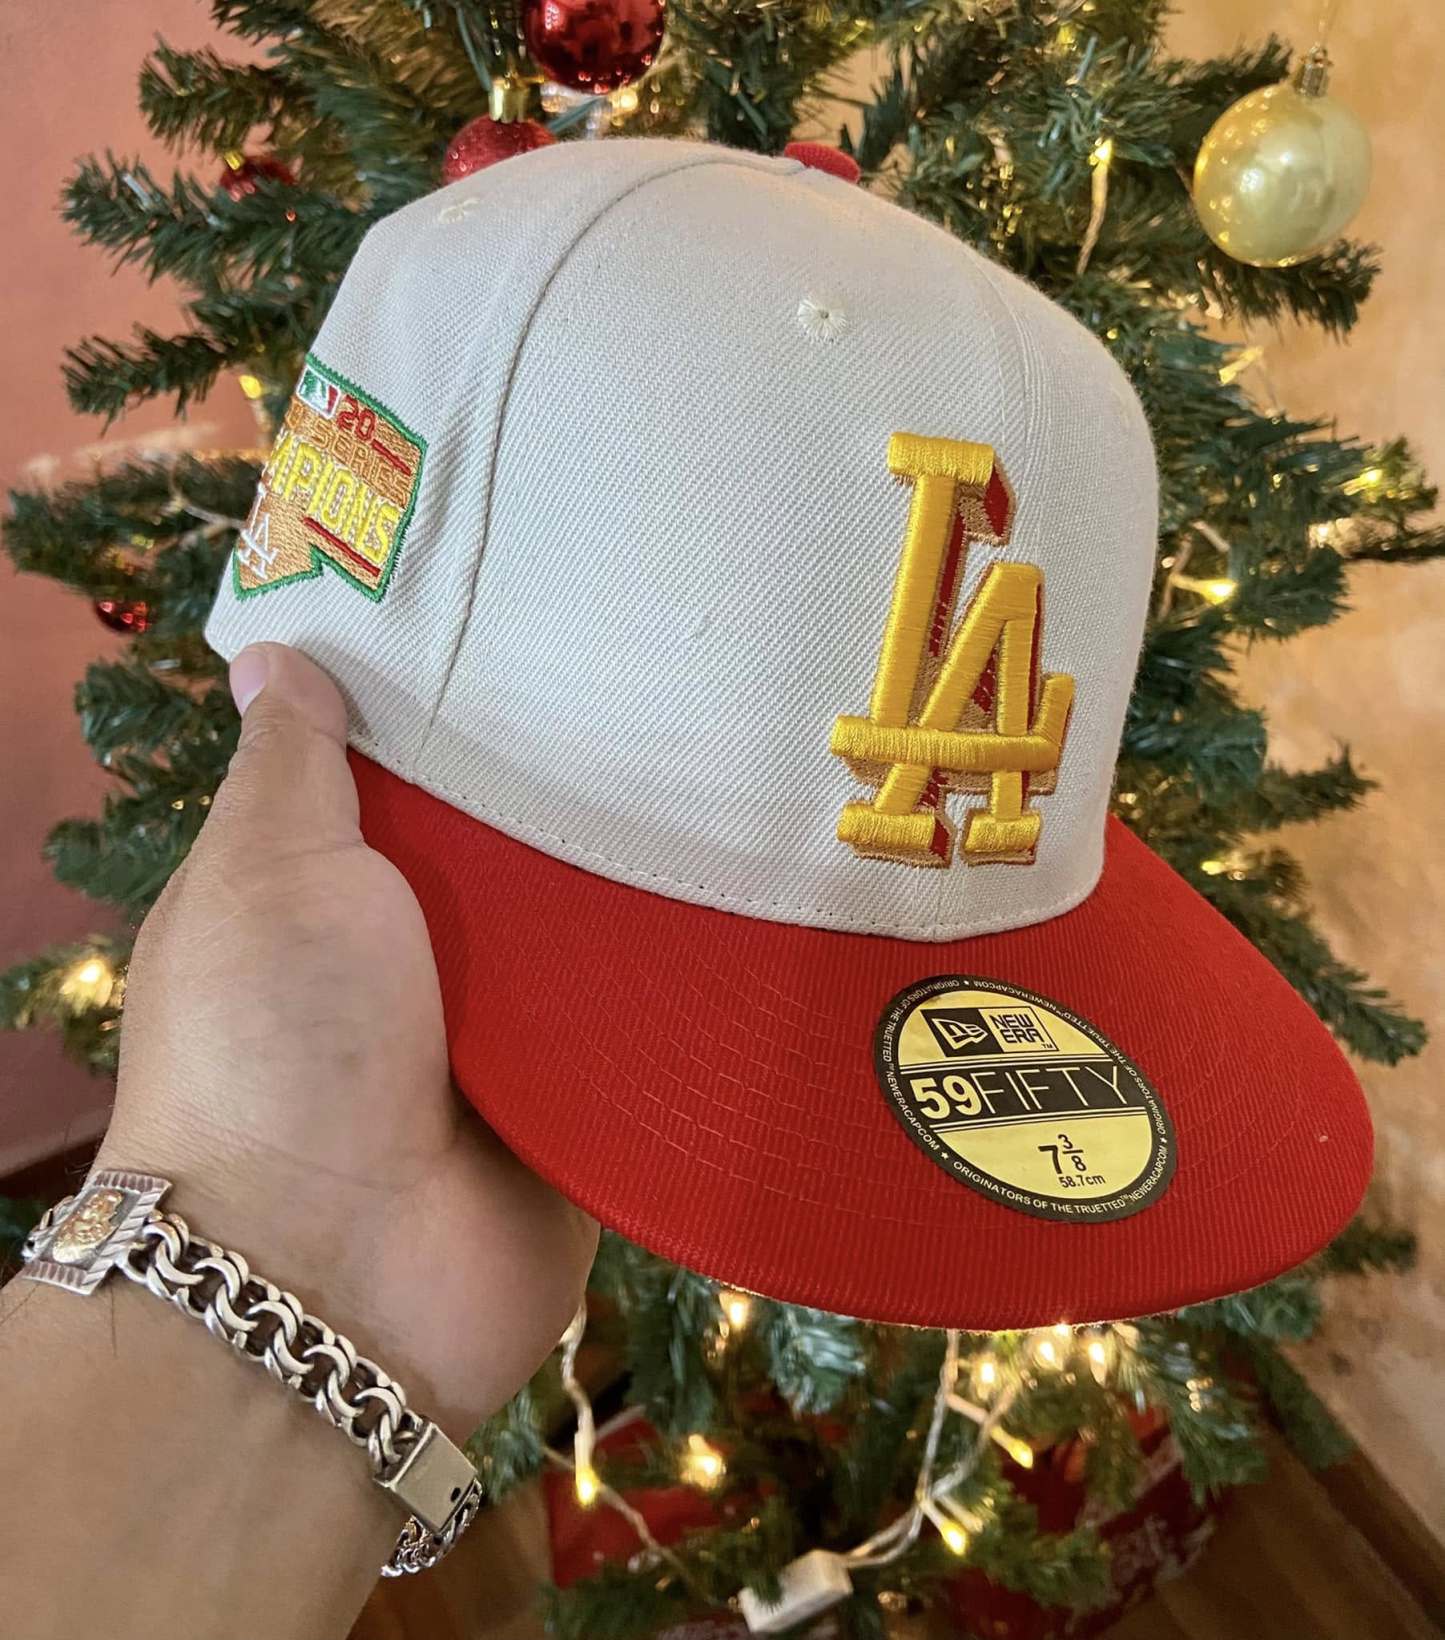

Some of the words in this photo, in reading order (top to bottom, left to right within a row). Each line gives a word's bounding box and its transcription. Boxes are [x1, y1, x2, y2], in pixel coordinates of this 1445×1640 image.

[829, 431, 1075, 868] LA
[988, 1013, 1034, 1029] NEW
[999, 1028, 1045, 1044] ERA
[909, 1065, 1127, 1120] 59FIFTY
[953, 1160, 1031, 1205] ORIGINATORS
[1032, 1199, 1048, 1209] OF
[1051, 1202, 1073, 1214] THE
